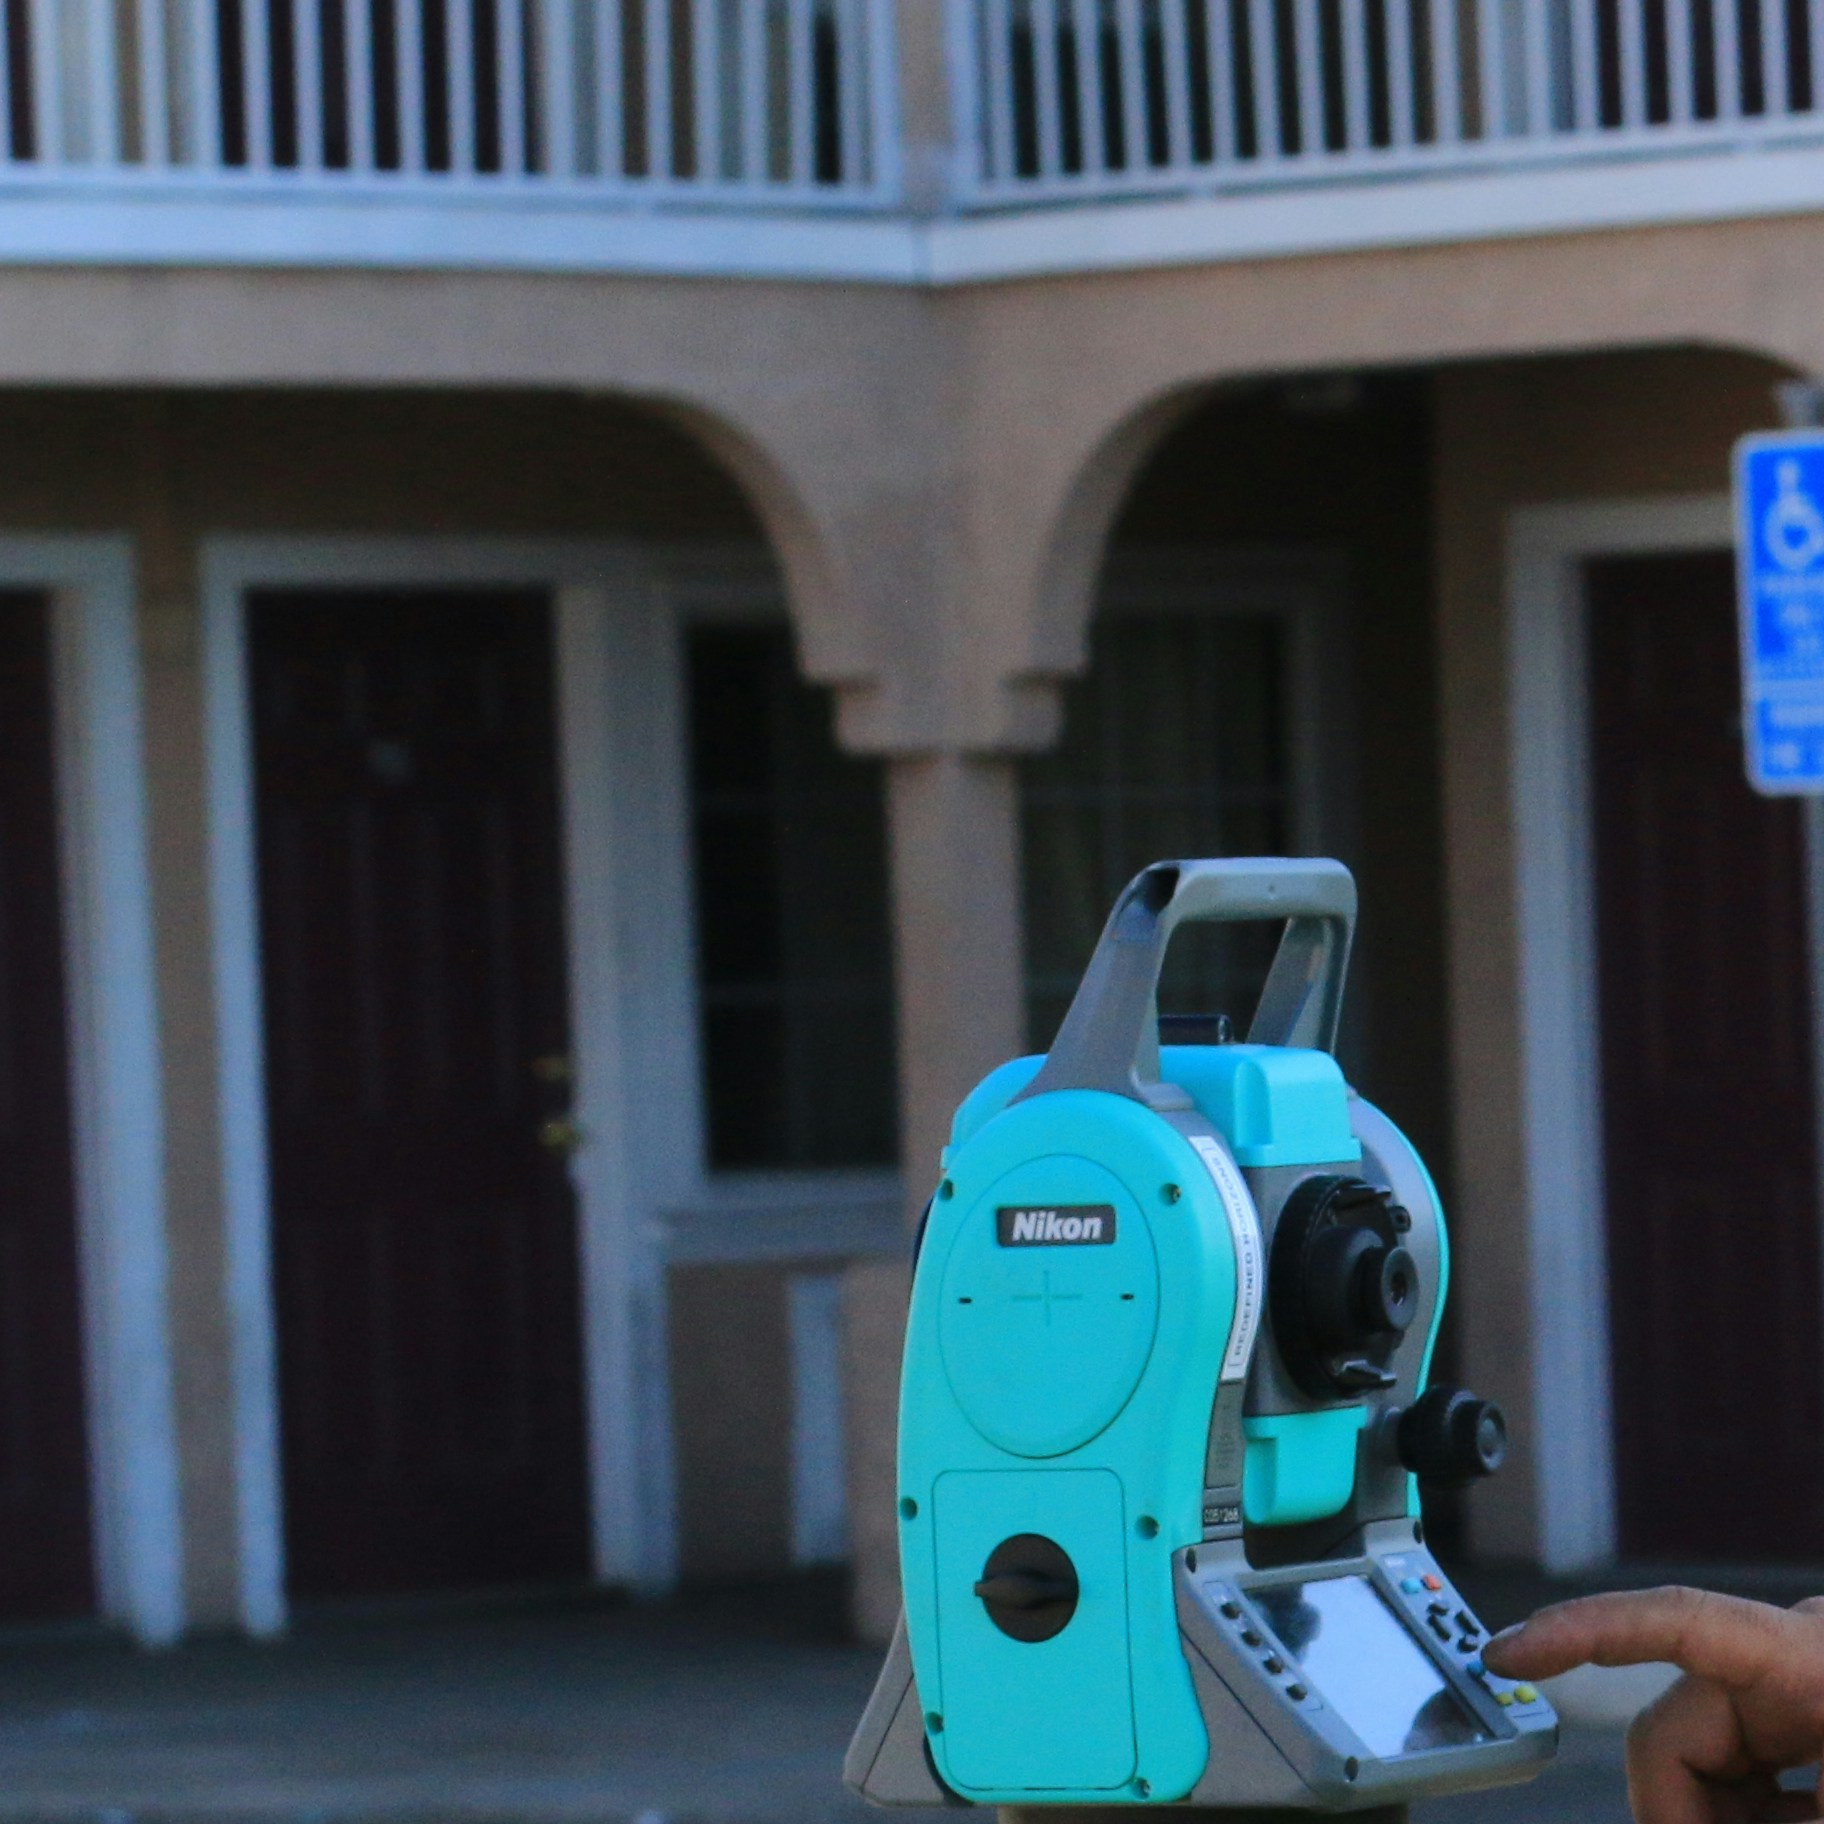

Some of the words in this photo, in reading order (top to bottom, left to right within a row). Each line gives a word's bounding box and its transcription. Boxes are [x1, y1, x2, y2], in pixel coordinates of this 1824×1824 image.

[1012, 1210, 1102, 1241] Nikon
[1212, 1156, 1250, 1246] HORIZONS
[1235, 1252, 1253, 1356] REDEFINED
